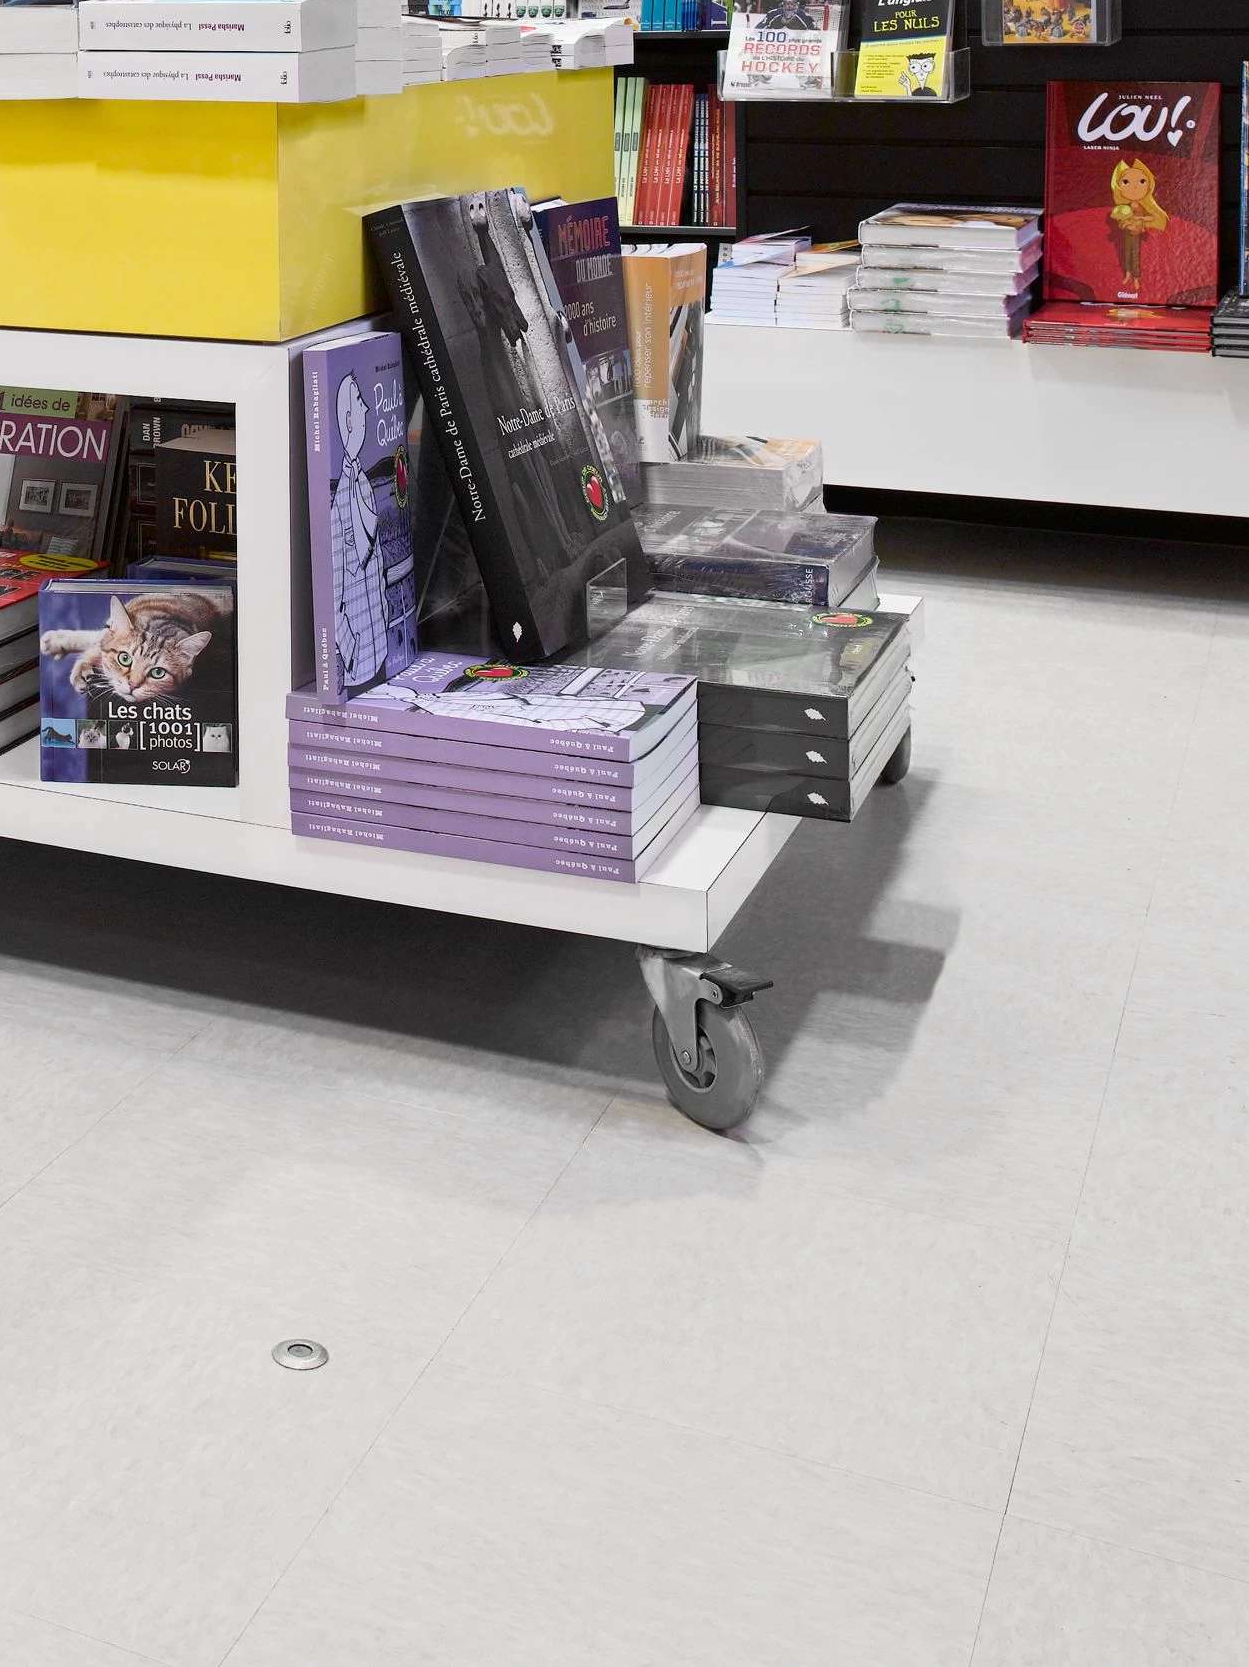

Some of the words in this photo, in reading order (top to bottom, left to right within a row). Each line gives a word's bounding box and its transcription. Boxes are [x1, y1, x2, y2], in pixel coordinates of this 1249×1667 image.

[895, 9, 916, 19] POUR
[105, 20, 141, 30] catastrophes
[156, 22, 182, 31] physique
[199, 22, 216, 31] Pessl
[218, 23, 244, 31] Marisha
[874, 20, 898, 33] LES
[904, 16, 940, 30] NULS
[757, 31, 786, 43] 100
[744, 42, 821, 56] RECORDS
[741, 61, 819, 74] HOCKEY
[152, 71, 179, 81] physique
[196, 73, 213, 82] Pessl
[214, 74, 241, 82] Marisha
[558, 215, 611, 255] MÉMOIRE
[587, 254, 613, 282] MONDE
[391, 251, 421, 315] médiévale
[581, 302, 595, 316] ans
[645, 282, 654, 323] intérieur
[583, 315, 617, 337] d'histoire
[412, 317, 442, 383] cathédrale
[312, 371, 320, 419] Rabagliati
[374, 379, 398, 415] Paul
[434, 384, 454, 418] Paris
[11, 393, 48, 411] idées
[52, 397, 70, 412] de
[497, 403, 545, 436] Notre-Dame
[554, 397, 577, 416] Paris
[447, 418, 458, 436] de
[454, 436, 487, 523] Notre-Dame
[108, 702, 138, 719] Les
[143, 702, 192, 720] chats
[303, 706, 347, 719] Rabagliati
[350, 713, 379, 723] Michel
[307, 731, 351, 743] Rabagliati
[353, 737, 382, 748] Michel
[550, 738, 582, 749] Québec
[593, 744, 614, 753] Paul
[152, 759, 191, 774] SOLAR
[305, 754, 349, 766] Rabagliati
[352, 761, 380, 770] Michel
[554, 764, 587, 774] Québec
[598, 769, 618, 778] Paul
